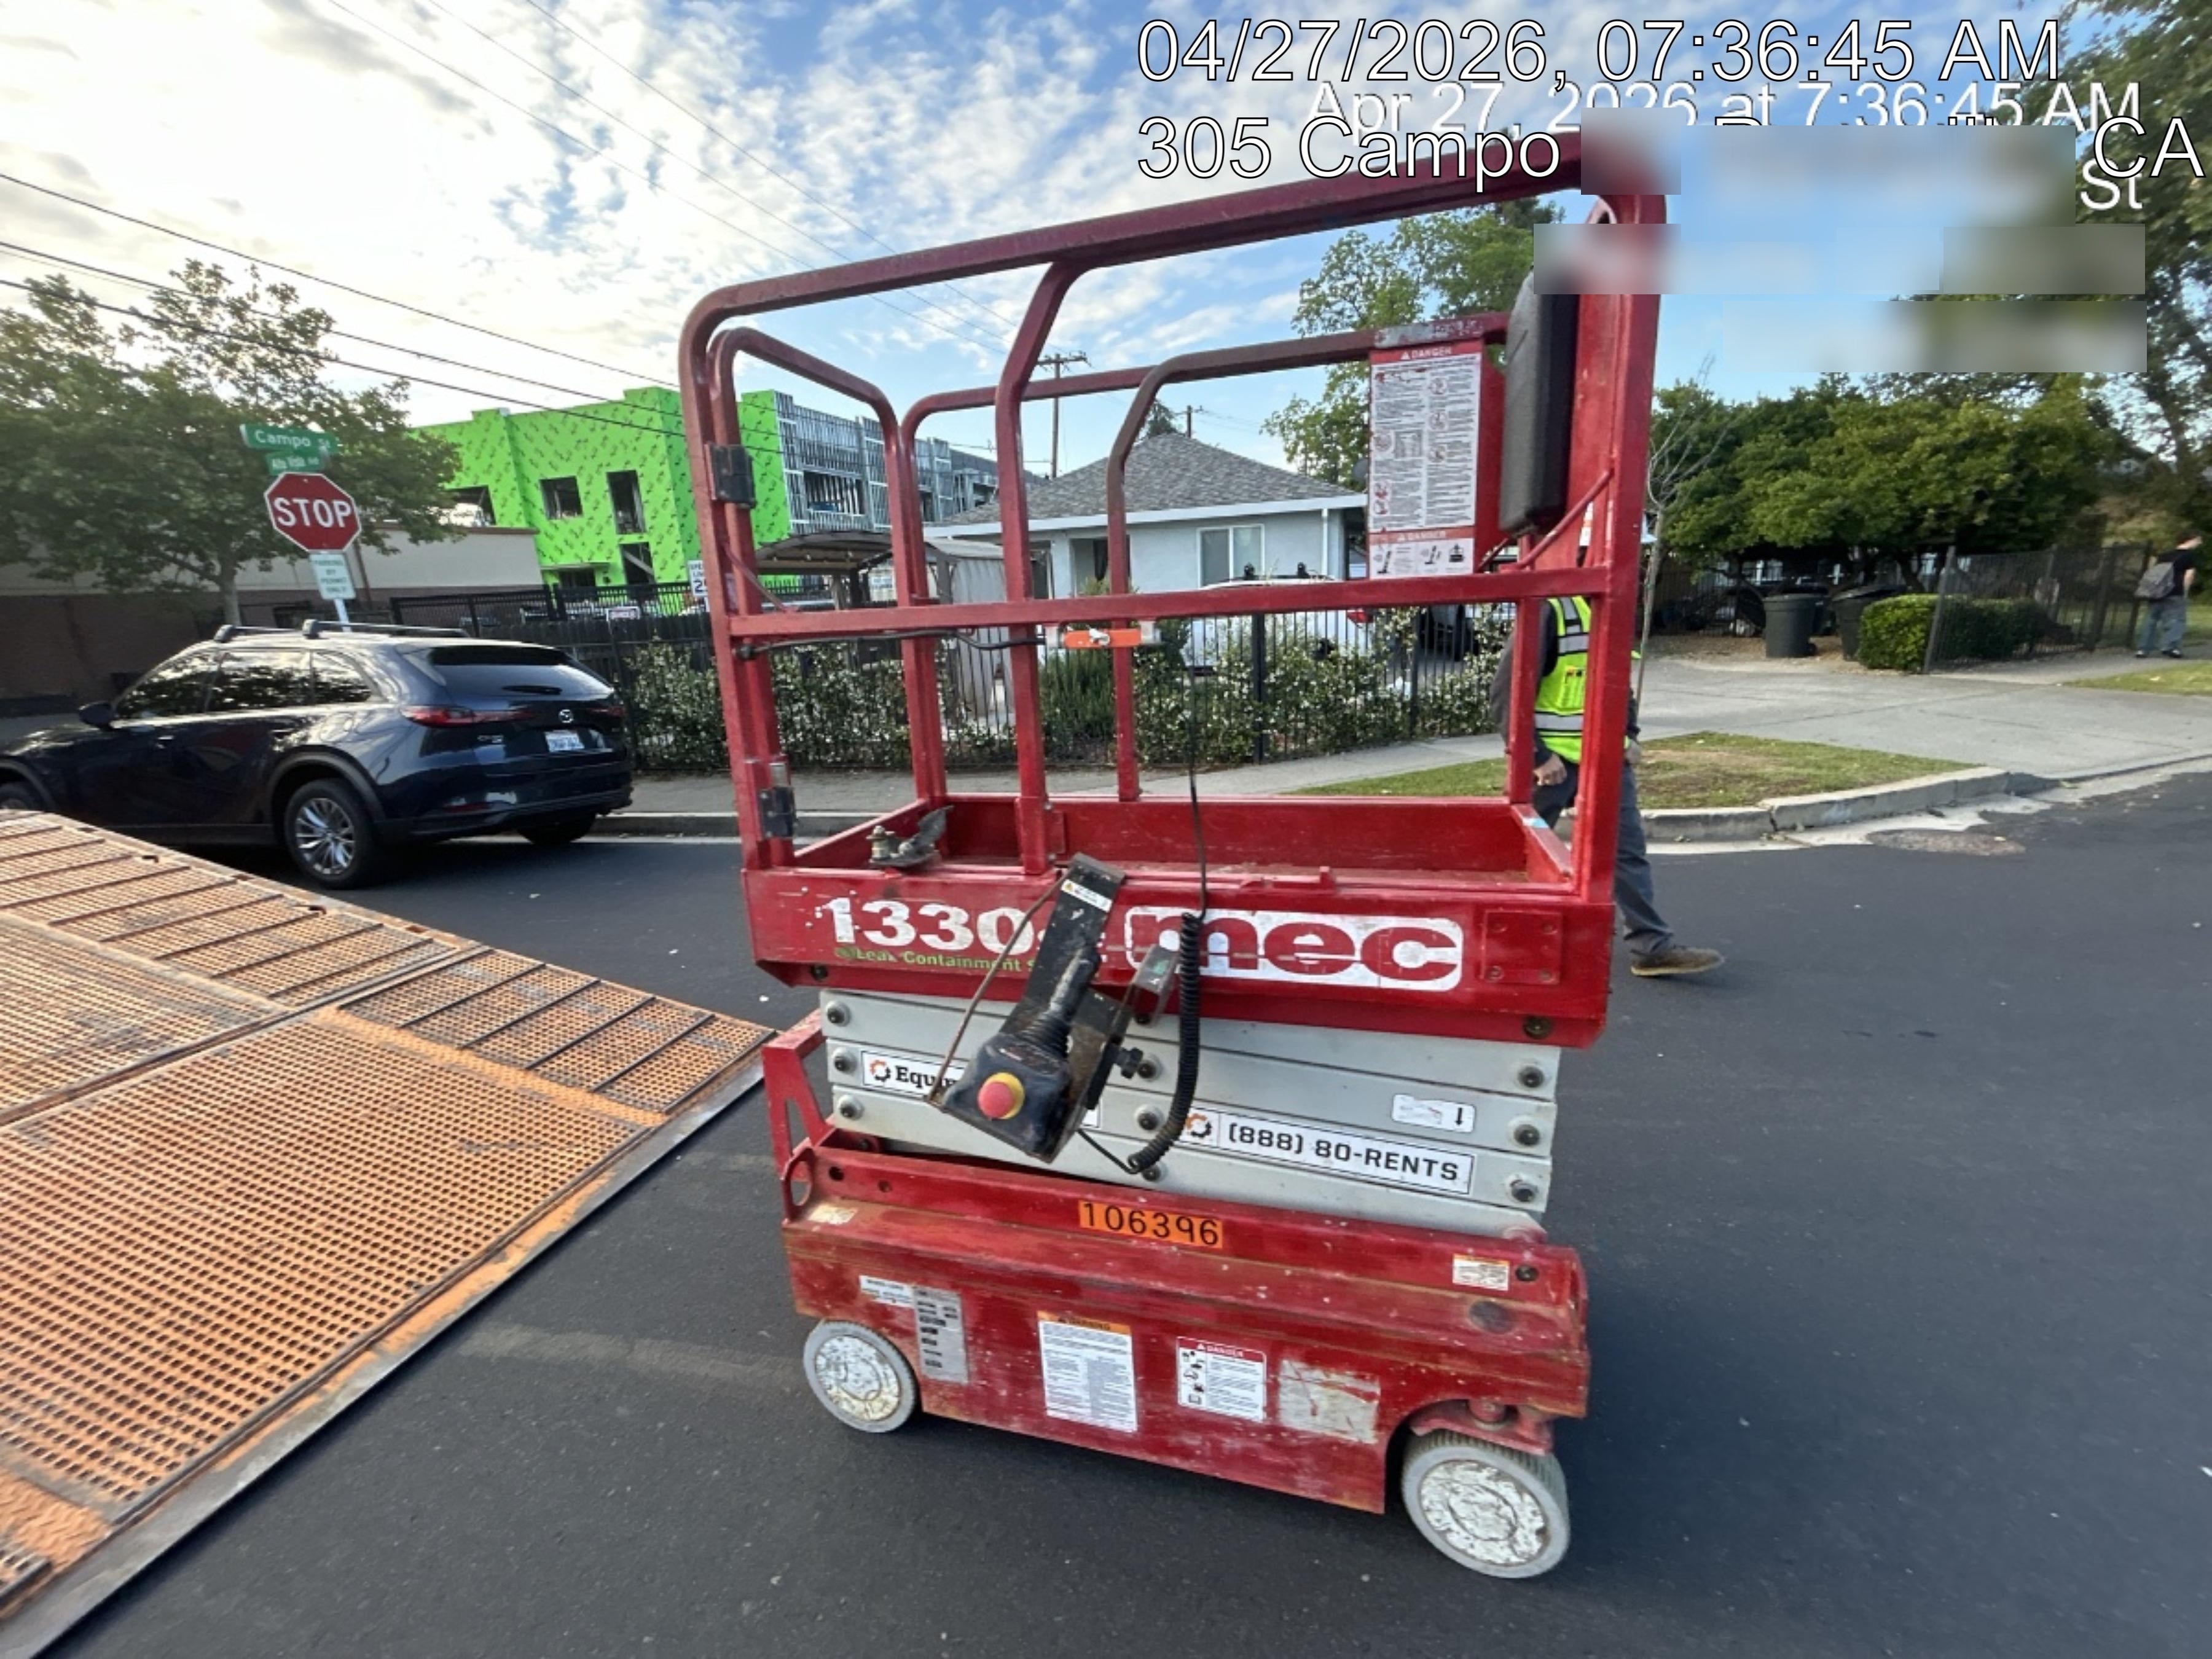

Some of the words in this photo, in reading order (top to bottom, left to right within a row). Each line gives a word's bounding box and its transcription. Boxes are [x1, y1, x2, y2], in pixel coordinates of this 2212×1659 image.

[1411, 347, 1452, 359] DANGER
[254, 429, 311, 449] Campo
[274, 497, 351, 528] STOP
[823, 897, 1107, 963] 1330
[1229, 1123, 1304, 1155] (888)
[1316, 1140, 1459, 1181] 80-RENTS
[1084, 1202, 1218, 1245] 106396
